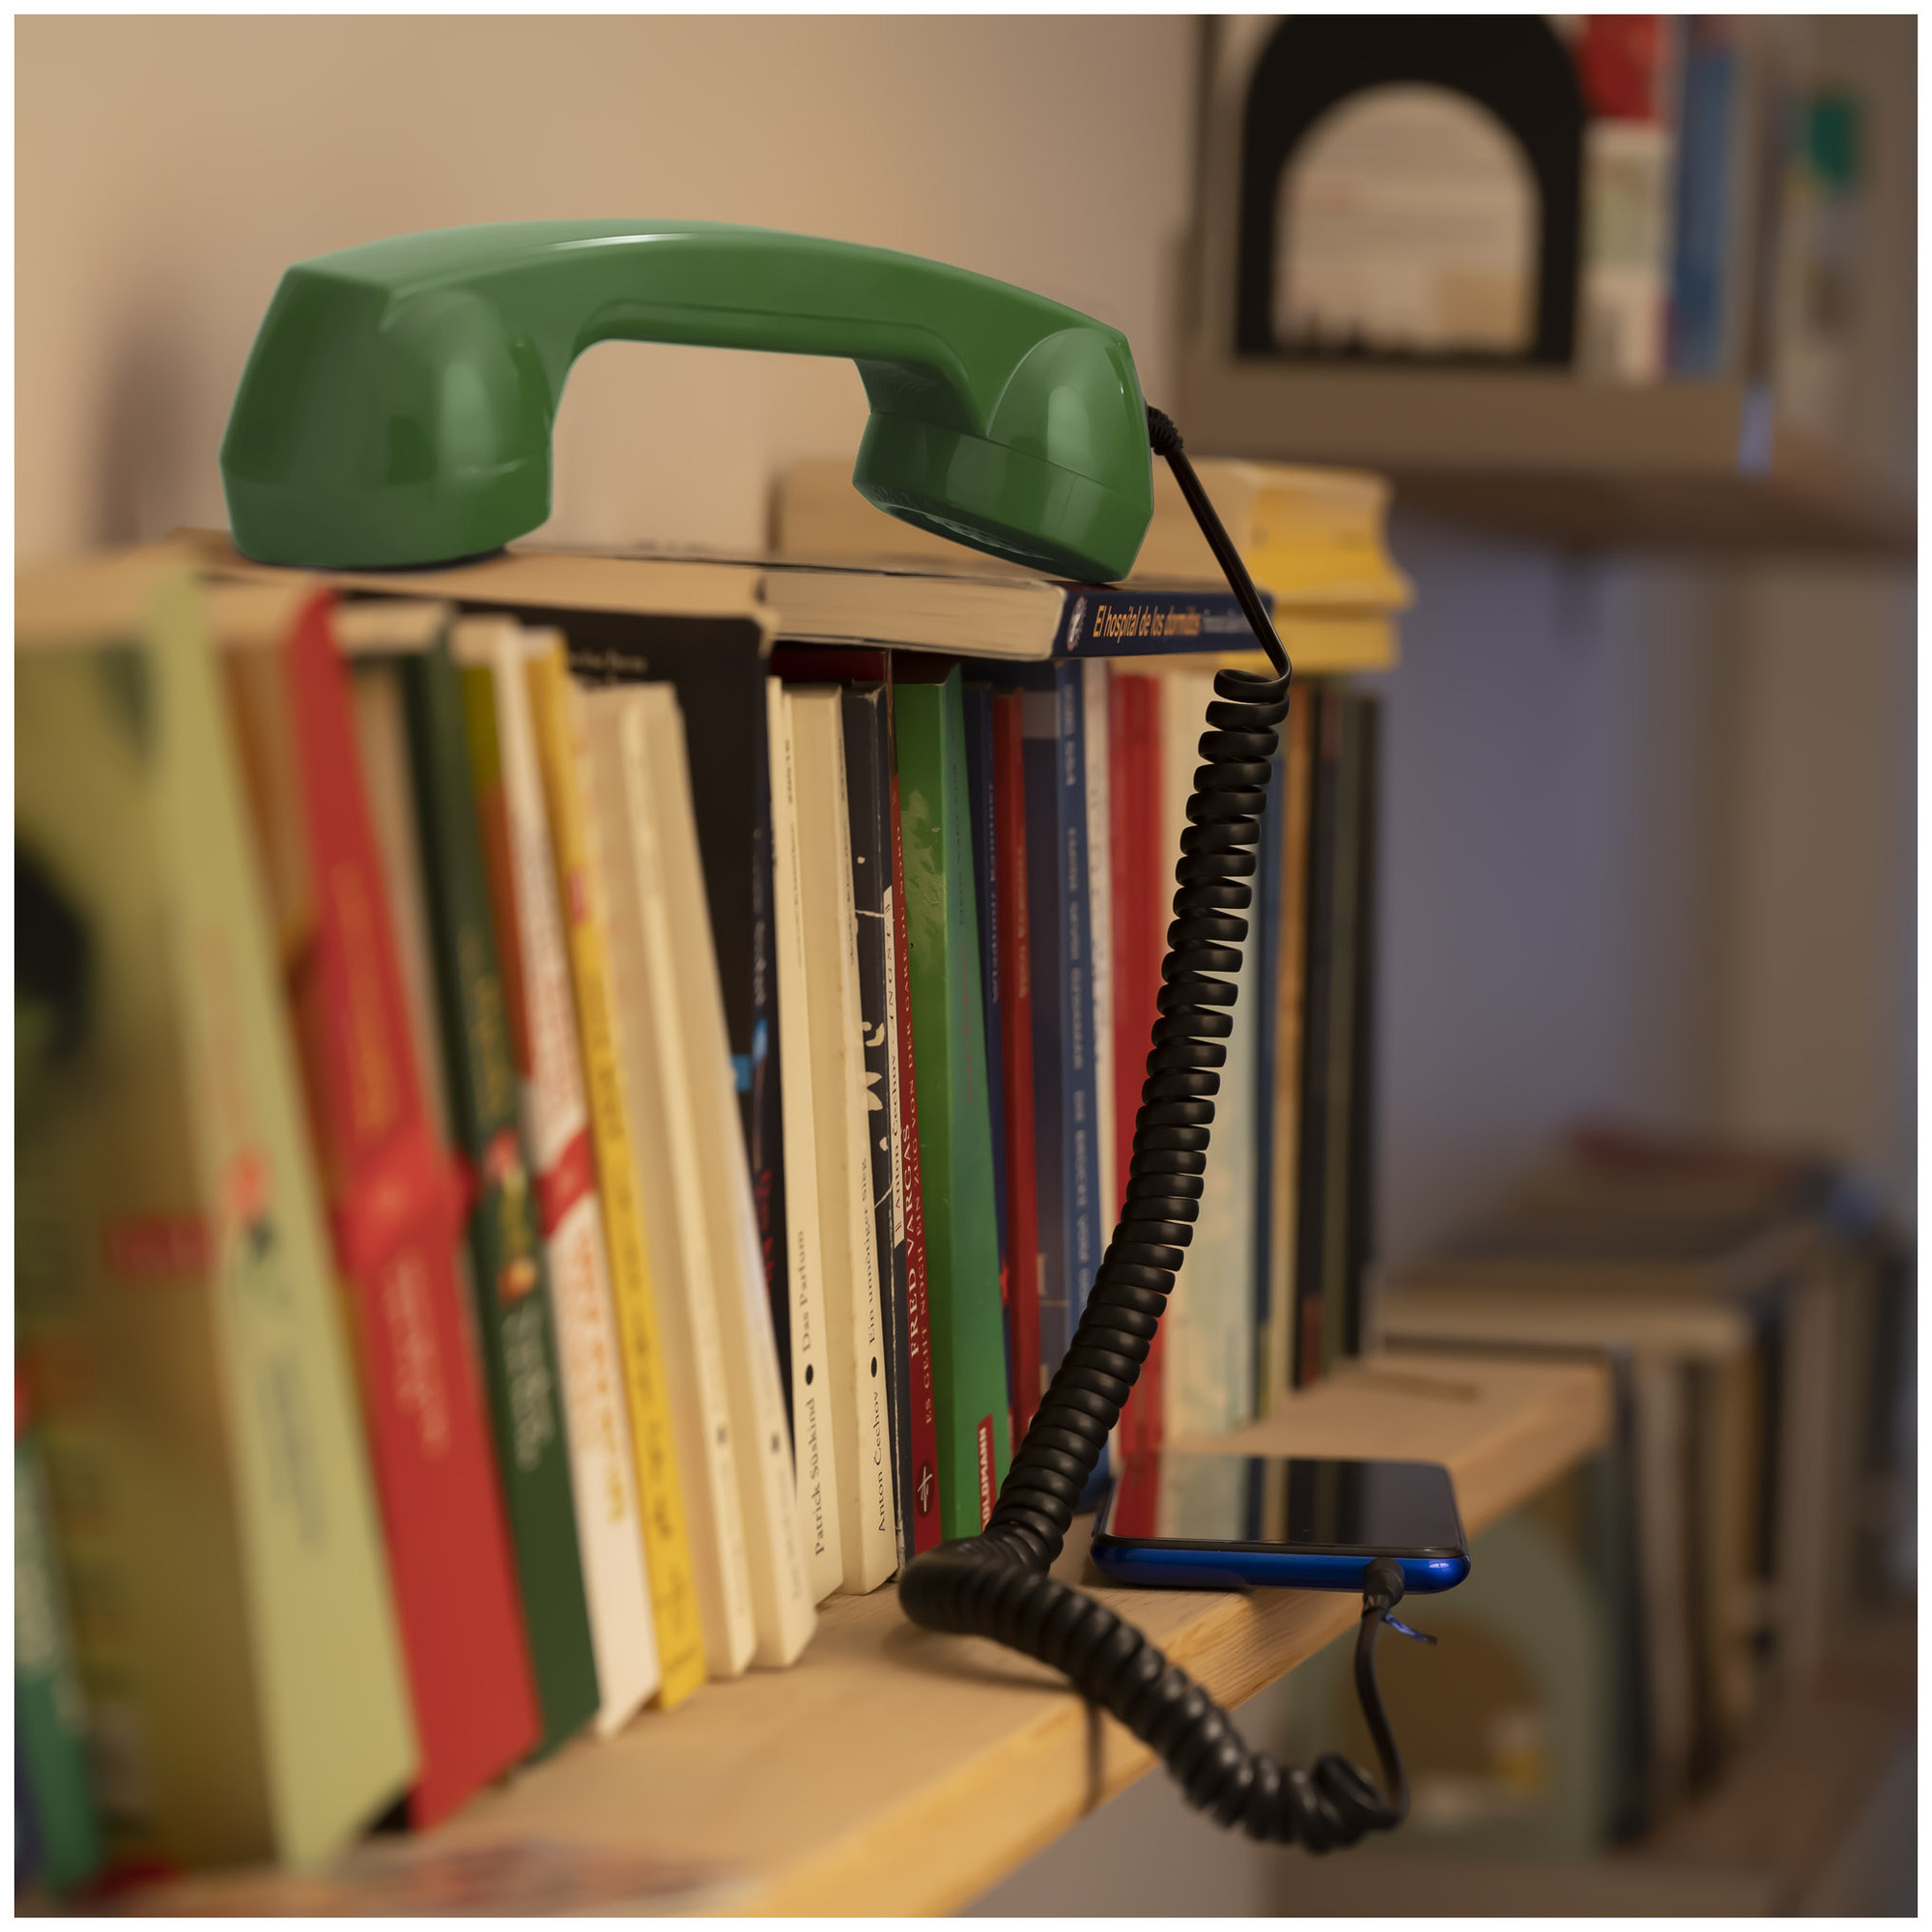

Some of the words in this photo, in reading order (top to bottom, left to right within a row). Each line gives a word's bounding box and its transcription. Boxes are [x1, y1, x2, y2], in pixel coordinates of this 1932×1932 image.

[1093, 605, 1106, 638] El
[1104, 605, 1141, 643] hospital
[1138, 605, 1151, 637] de
[1151, 605, 1164, 637] los
[886, 923, 895, 1030] ANGST
[891, 1055, 899, 1136] Čechov
[903, 1123, 915, 1255] VARGAS
[795, 1231, 810, 1306] Parfum
[864, 1207, 873, 1303] unnötiger
[918, 1246, 926, 1315] NOCH
[801, 1311, 811, 1352] Das
[908, 1268, 920, 1357] FRED
[921, 1326, 930, 1389] GEHT
[805, 1398, 820, 1479] Süskind
[871, 1391, 882, 1466] Čechov
[924, 1399, 932, 1425] ES
[812, 1483, 825, 1556] Patrick
[877, 1470, 886, 1533] Anton
